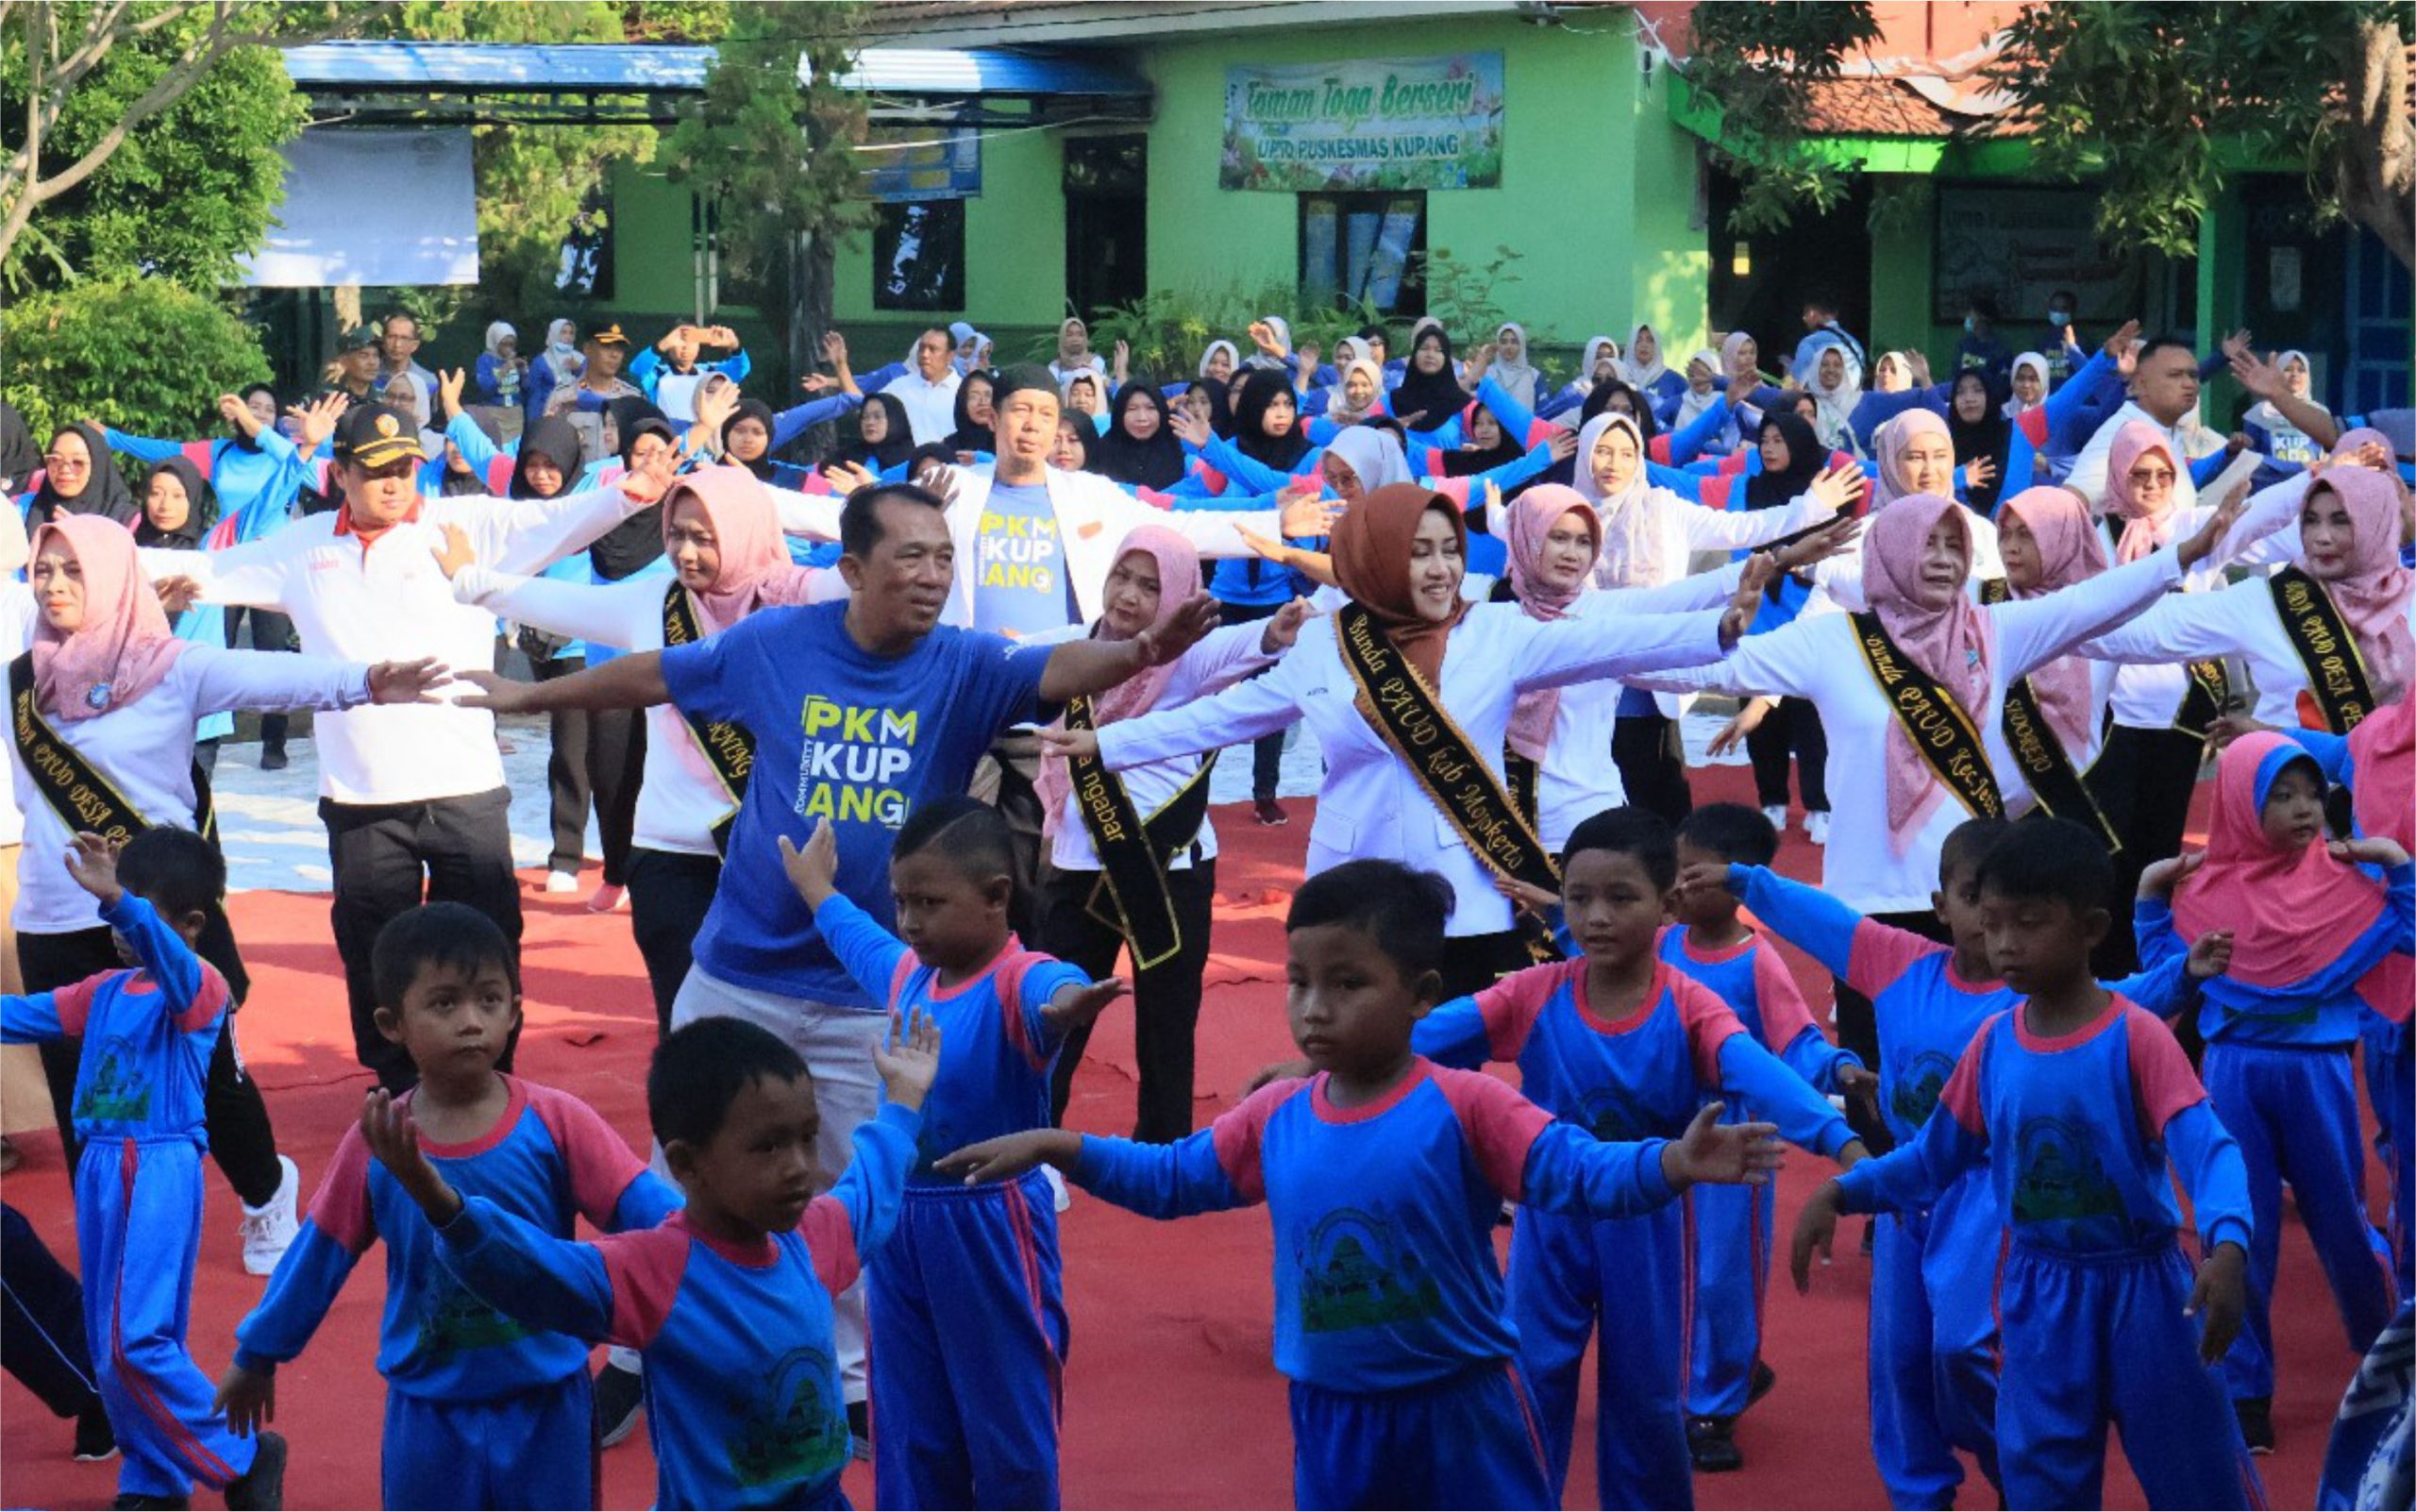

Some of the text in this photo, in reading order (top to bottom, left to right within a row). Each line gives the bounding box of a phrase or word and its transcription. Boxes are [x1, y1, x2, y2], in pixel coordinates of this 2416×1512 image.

[1246, 74, 1474, 133] Taman Toga Berseri
[1257, 134, 1458, 160] UPTD PUSKESMAS KUPANG
[980, 511, 1057, 541] PKM
[986, 535, 1053, 563] KUP
[985, 562, 1054, 594] ANG
[2302, 615, 2336, 654] PAUD
[2321, 656, 2355, 697] DESA
[805, 700, 918, 747] PKM
[1898, 686, 1955, 748] PAUD
[810, 741, 912, 783] KUP
[1349, 613, 1390, 674] Bunda
[1380, 677, 1438, 746] PAUD
[1455, 783, 1525, 870] Mojokerto
[34, 743, 75, 785] PAUD
[69, 784, 112, 827] DESA
[804, 782, 906, 825] ANG
[1083, 769, 1125, 843] ngabar
